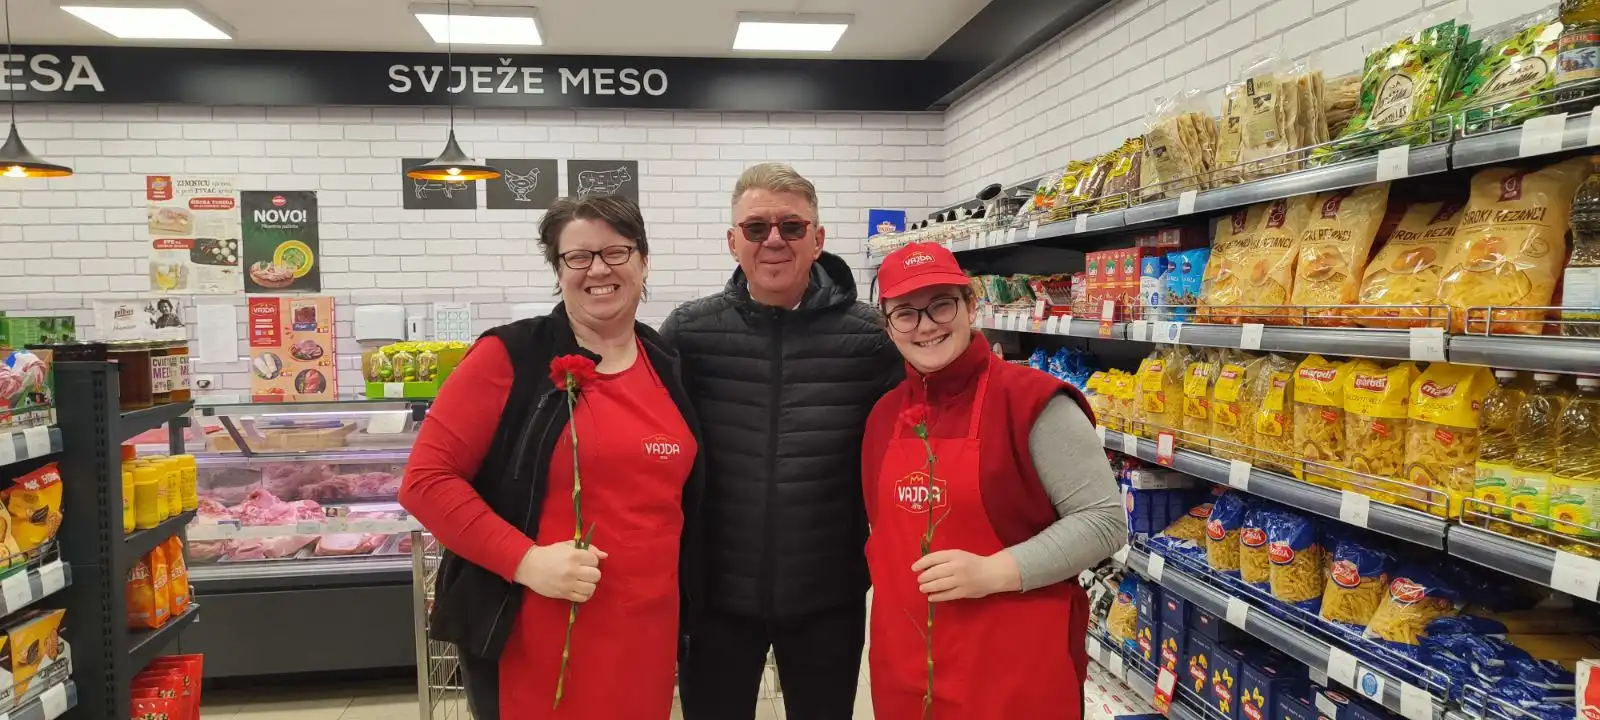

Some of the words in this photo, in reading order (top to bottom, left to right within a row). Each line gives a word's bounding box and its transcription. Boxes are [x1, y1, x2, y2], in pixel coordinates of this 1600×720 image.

[388, 57, 544, 94] SVJEŽE
[558, 67, 668, 96] MESO
[253, 209, 307, 223] NOVO!
[904, 254, 933, 267] VAJDA
[645, 442, 680, 455] VAJDA
[897, 485, 941, 503] VAJDA
